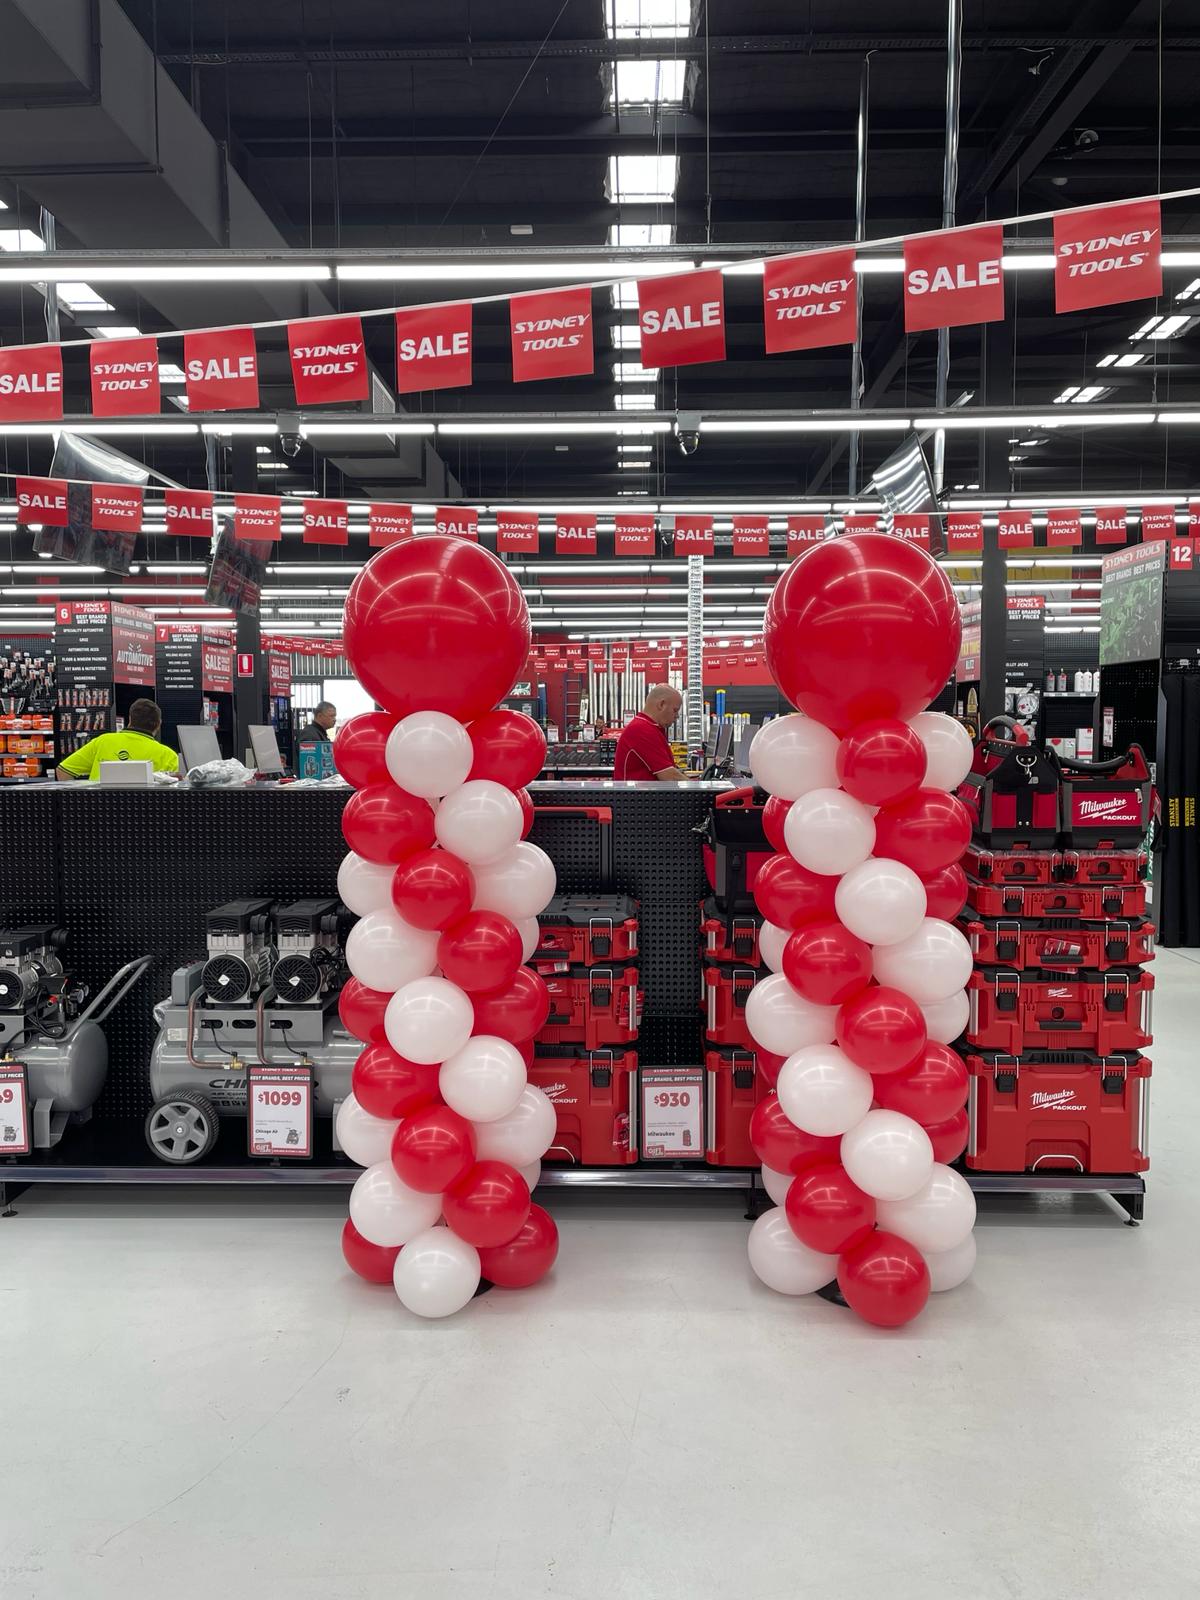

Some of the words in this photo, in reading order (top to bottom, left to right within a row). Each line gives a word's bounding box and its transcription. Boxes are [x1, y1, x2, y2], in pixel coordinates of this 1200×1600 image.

[1058, 229, 1158, 256] SYDNEY
[908, 260, 1000, 294] SALE
[767, 279, 853, 301] SYDNEY
[514, 314, 590, 333] SYDNEY
[642, 302, 720, 334] SALE
[293, 344, 362, 358] SYDNEY
[400, 332, 468, 361] SALE
[93, 362, 157, 374] SYDNEY
[188, 357, 255, 381] SALE
[0, 373, 60, 394] SALE
[19, 494, 66, 509] SALE
[167, 506, 212, 519] SALE
[304, 515, 347, 527] SALE
[436, 523, 477, 535] SALE
[1097, 519, 1126, 530] SALE
[557, 528, 596, 538] SALE
[677, 530, 713, 540] SALE
[789, 530, 824, 541] SALE
[895, 528, 929, 538] SALE
[1000, 524, 1032, 535] SALE
[1105, 552, 1133, 568] SYDNEY
[1136, 543, 1161, 559] TOOLS
[1172, 546, 1191, 562] 12
[1134, 564, 1144, 576] BEST
[1145, 560, 1160, 573] PRICES
[60, 608, 68, 619] 6
[160, 628, 166, 638] 7
[116, 650, 153, 666] AUTOMOTIVE
[205, 654, 221, 670] SALE
[1078, 798, 1128, 815] Milwaukee
[258, 1091, 302, 1106] $1099
[654, 1092, 690, 1108] $930
[1030, 1089, 1075, 1106] Milwaukee
